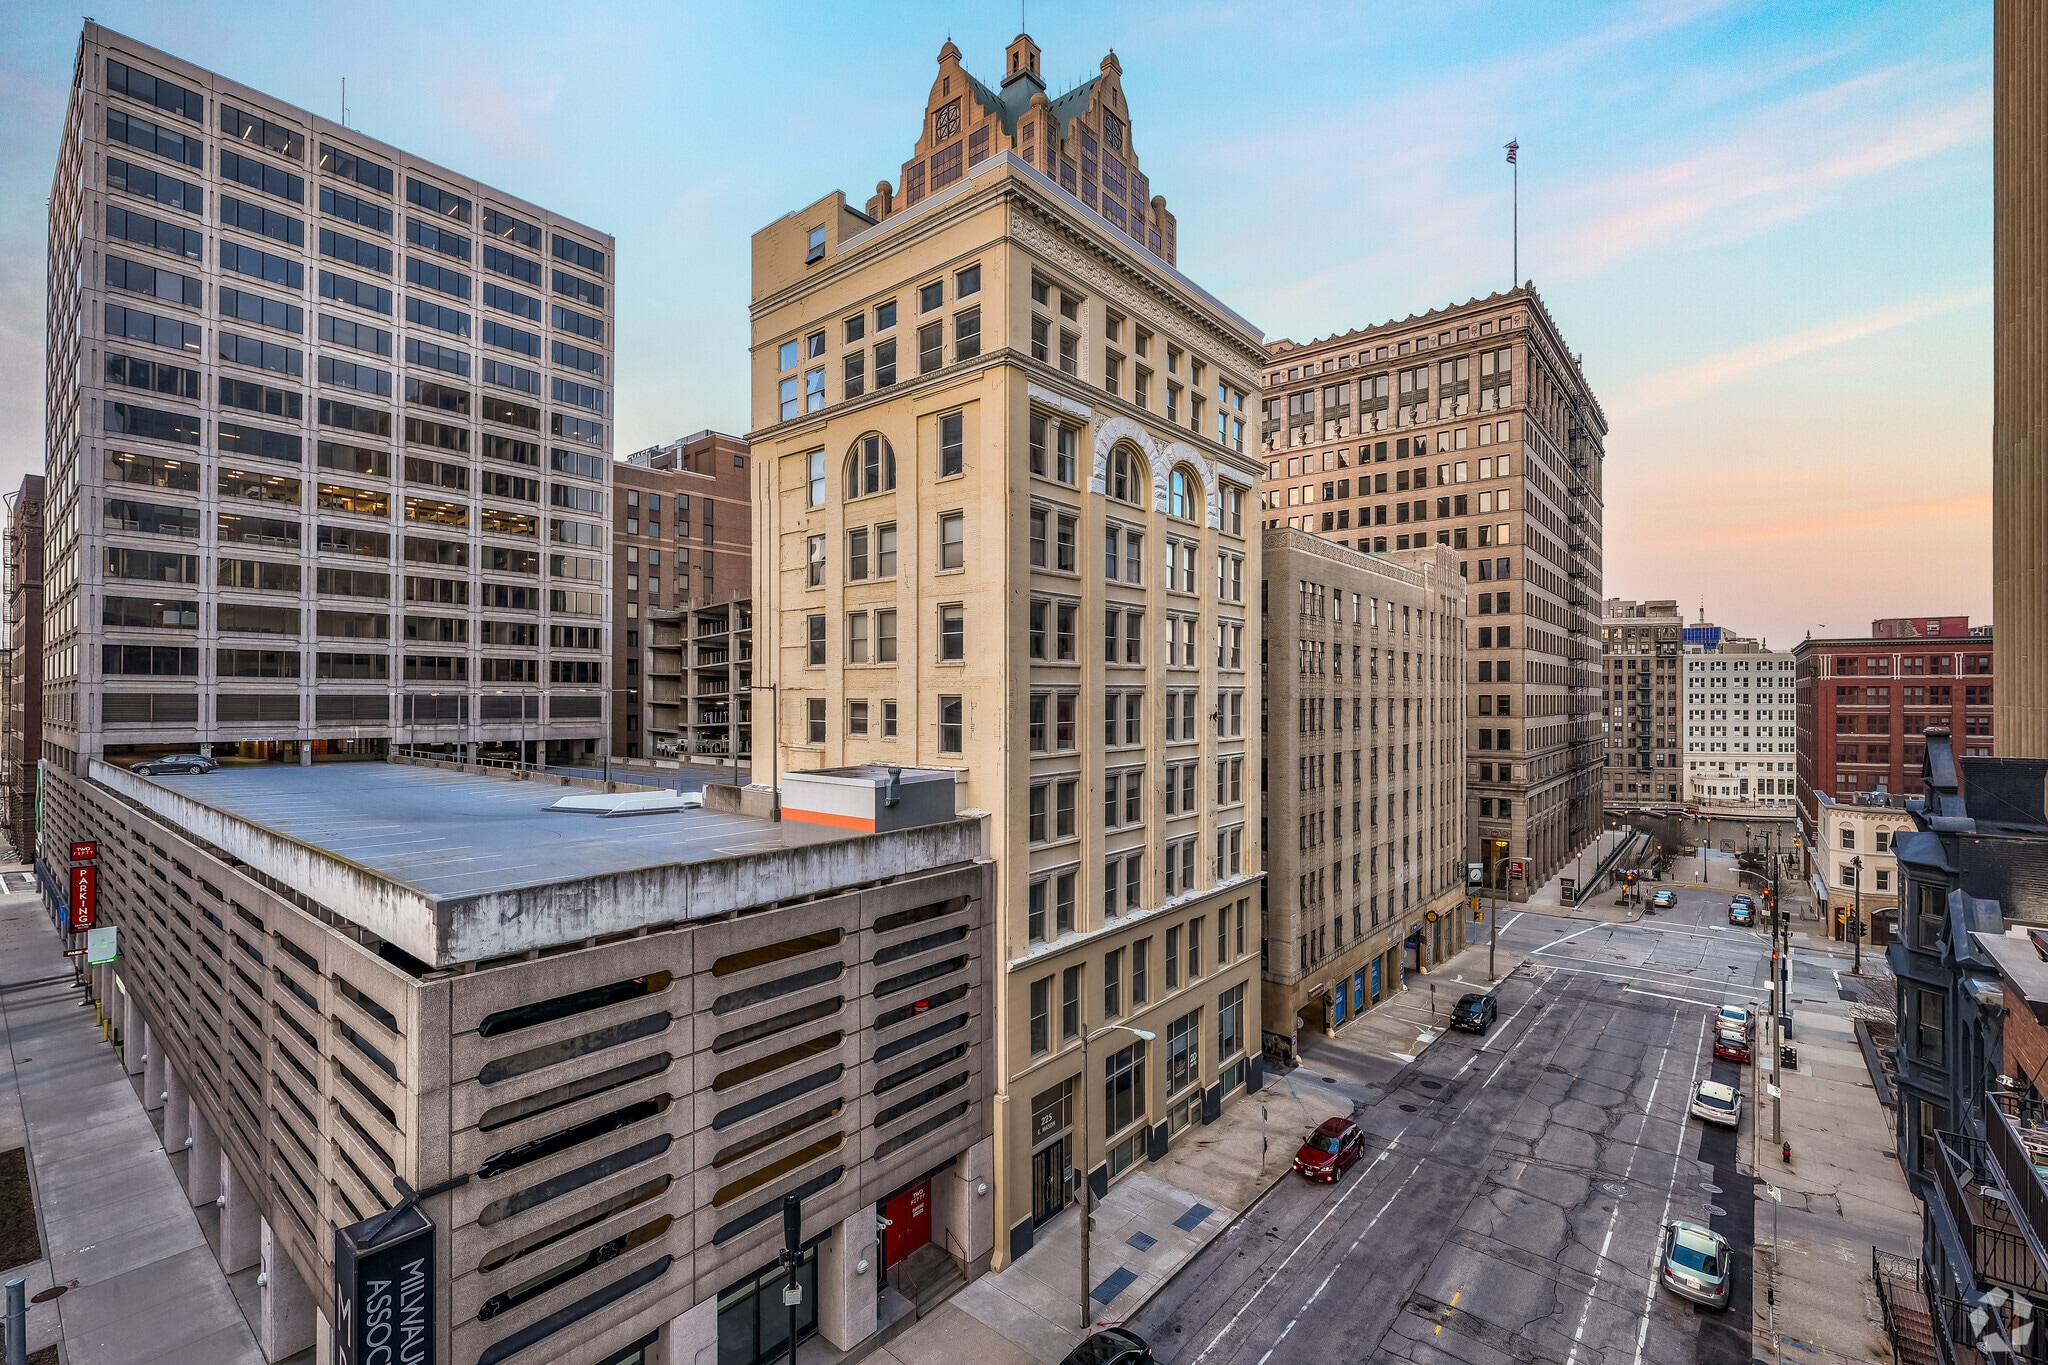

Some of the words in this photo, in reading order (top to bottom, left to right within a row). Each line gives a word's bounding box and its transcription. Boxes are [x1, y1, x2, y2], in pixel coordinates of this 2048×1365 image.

[79, 869, 88, 923] PARKING
[1040, 1112, 1053, 1126] 225
[1042, 1120, 1056, 1133] MASON
[912, 1188, 924, 1199] TWO
